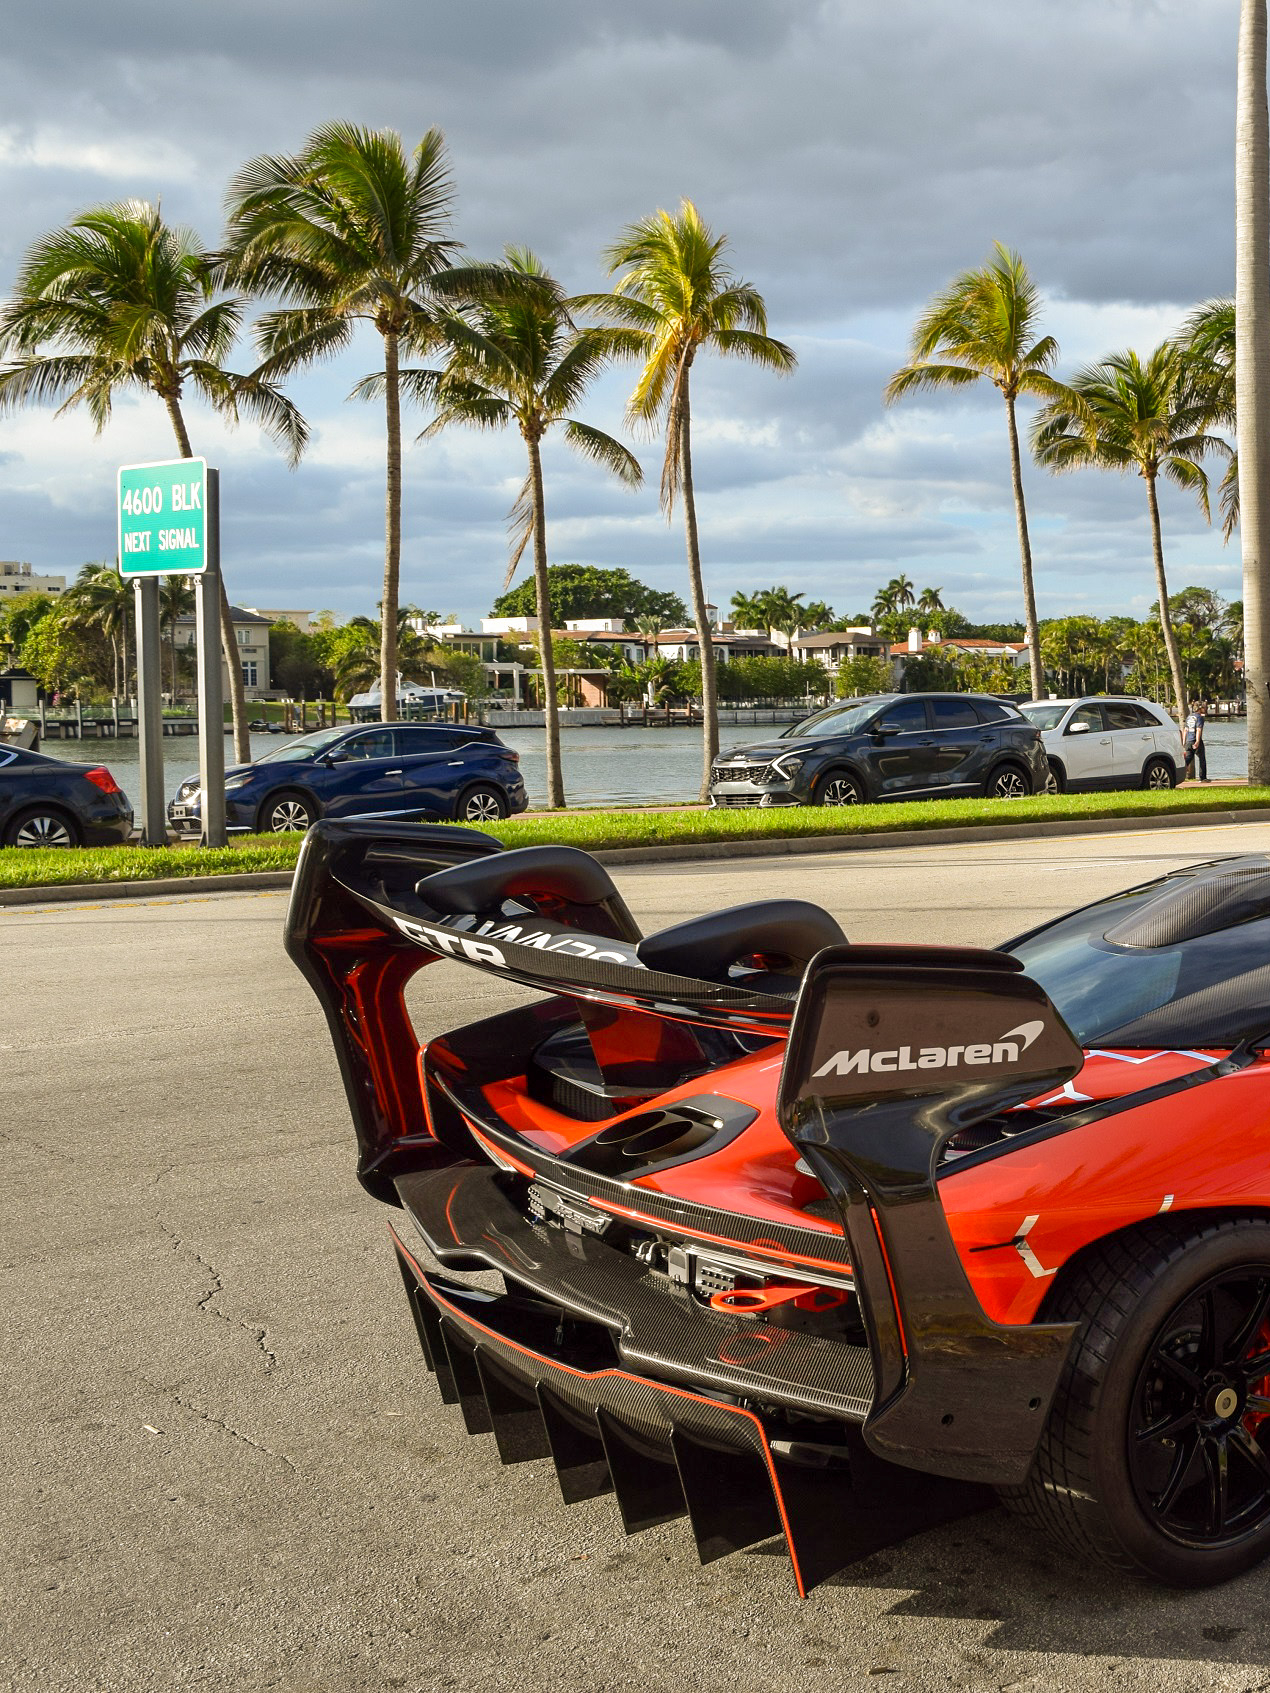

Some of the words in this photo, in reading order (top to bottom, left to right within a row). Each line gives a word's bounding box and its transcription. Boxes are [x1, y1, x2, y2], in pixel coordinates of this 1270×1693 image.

[122, 486, 162, 515] 4600
[172, 482, 201, 511] BLK
[124, 531, 151, 552] NEXT
[158, 528, 199, 550] SIGNAL
[393, 916, 510, 969] GTR
[811, 1041, 1019, 1078] McLaren
